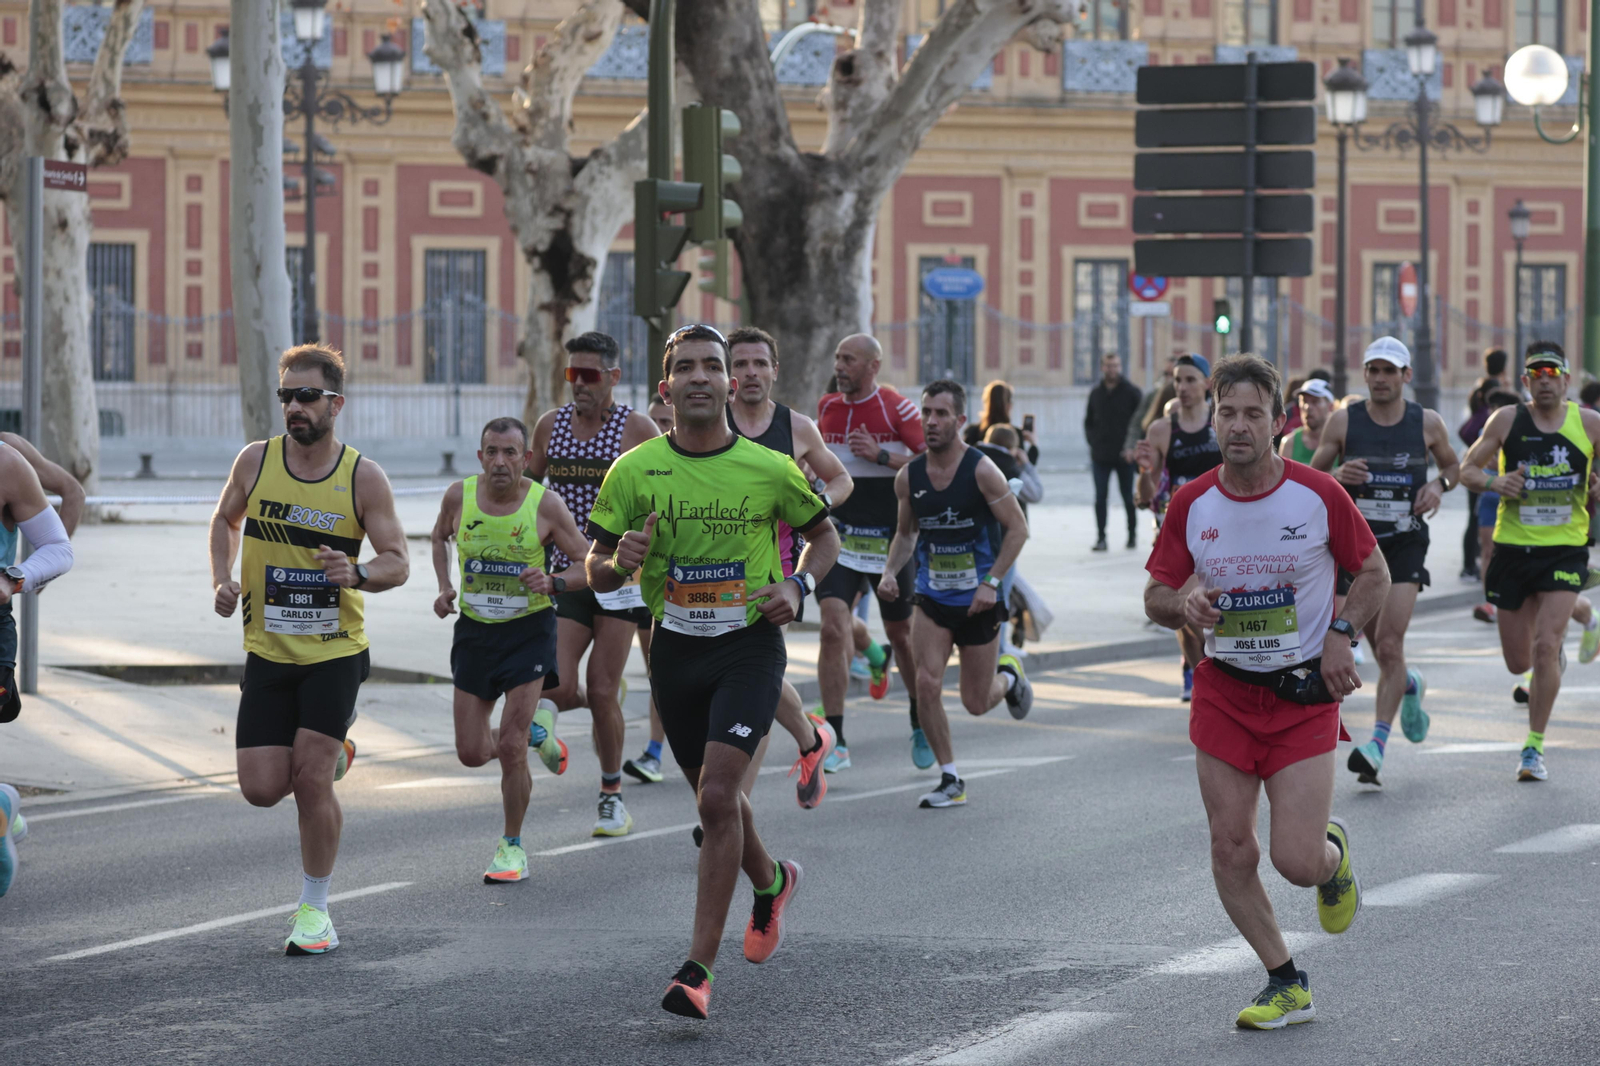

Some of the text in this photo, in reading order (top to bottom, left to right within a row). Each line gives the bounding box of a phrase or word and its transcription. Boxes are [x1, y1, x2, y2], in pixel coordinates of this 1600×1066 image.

[1375, 474, 1406, 483] ZURICH
[1537, 481, 1567, 489] ZURICH
[678, 495, 750, 519] Fartleck
[701, 518, 748, 541] Sport
[853, 527, 883, 536] ZURIC
[1201, 526, 1219, 542] edp
[937, 545, 966, 553] ZURICH
[1206, 553, 1299, 567] EDP MEDIO MARATÓN
[484, 564, 520, 574] ZURICH
[686, 567, 734, 580] ZURICH
[1210, 563, 1295, 577] DE SEVILLA
[485, 582, 506, 592] 1221
[289, 593, 313, 605] 1981
[487, 596, 503, 605] RUIZ
[687, 592, 717, 604] 3886
[1235, 592, 1285, 608] ZURICH
[281, 609, 322, 619] CARLOS V
[689, 608, 716, 620] BABÁ
[1239, 620, 1268, 633] 1467
[1233, 638, 1280, 650] JOSÉ LUIS
